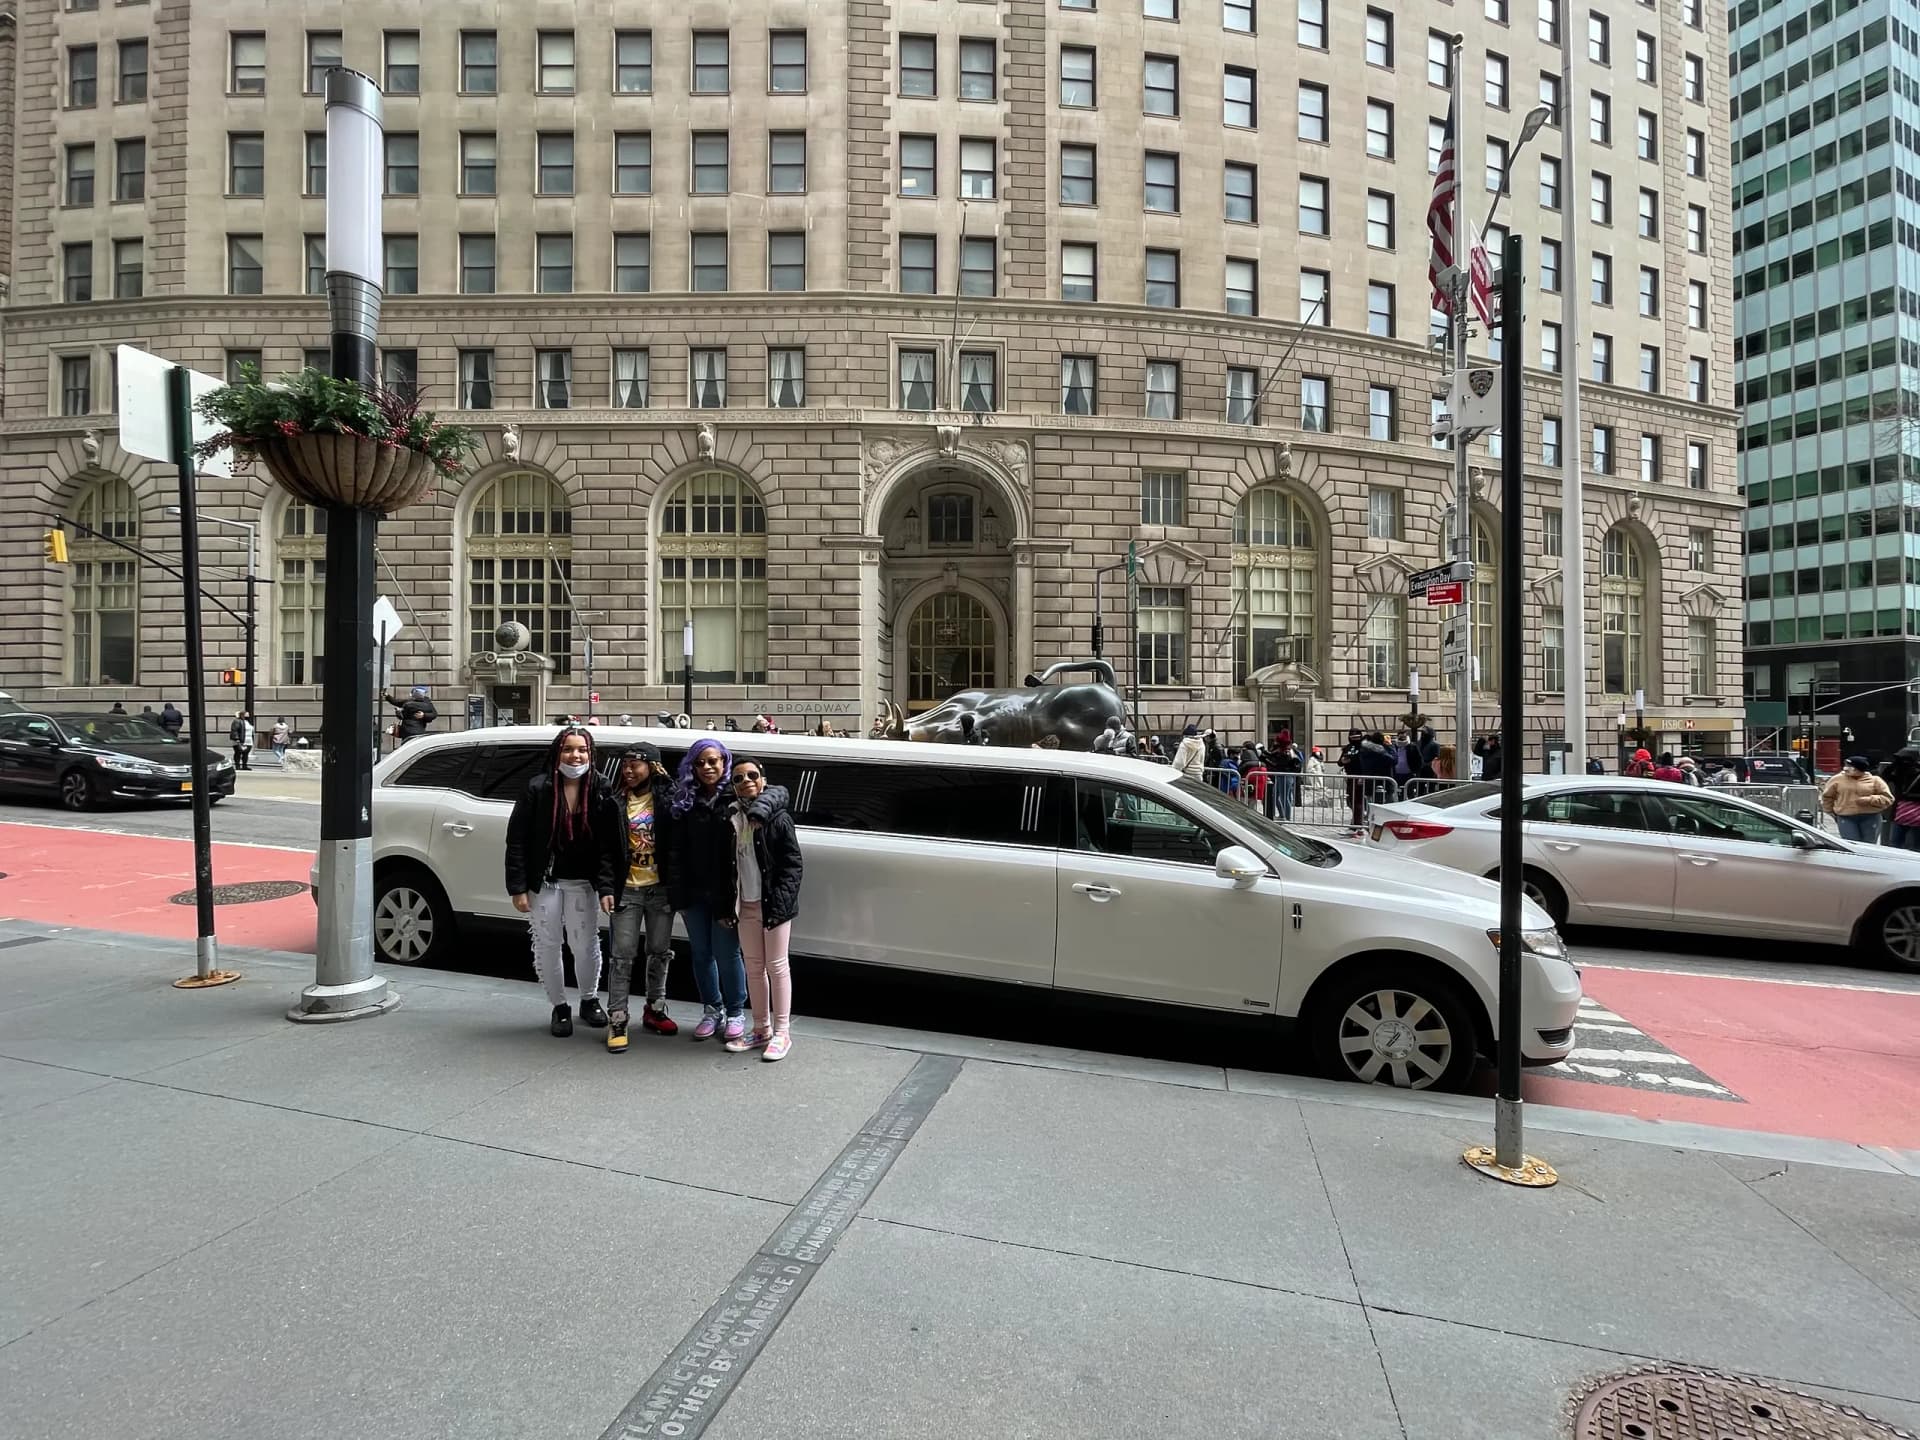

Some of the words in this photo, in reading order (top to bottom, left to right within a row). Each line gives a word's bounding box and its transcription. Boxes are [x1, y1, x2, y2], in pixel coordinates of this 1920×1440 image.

[926, 414, 1000, 425] BROADWAY
[1440, 572, 1450, 583] Day
[753, 703, 768, 713] 26
[777, 703, 850, 713] BROADWAY
[1661, 719, 1682, 730] HSBC
[735, 1275, 768, 1301] ONE
[661, 1374, 721, 1436] OTHER
[708, 1348, 738, 1372] BY
[728, 1276, 795, 1347] CLARENCE
[795, 1199, 849, 1261] CHAMBERLIN
